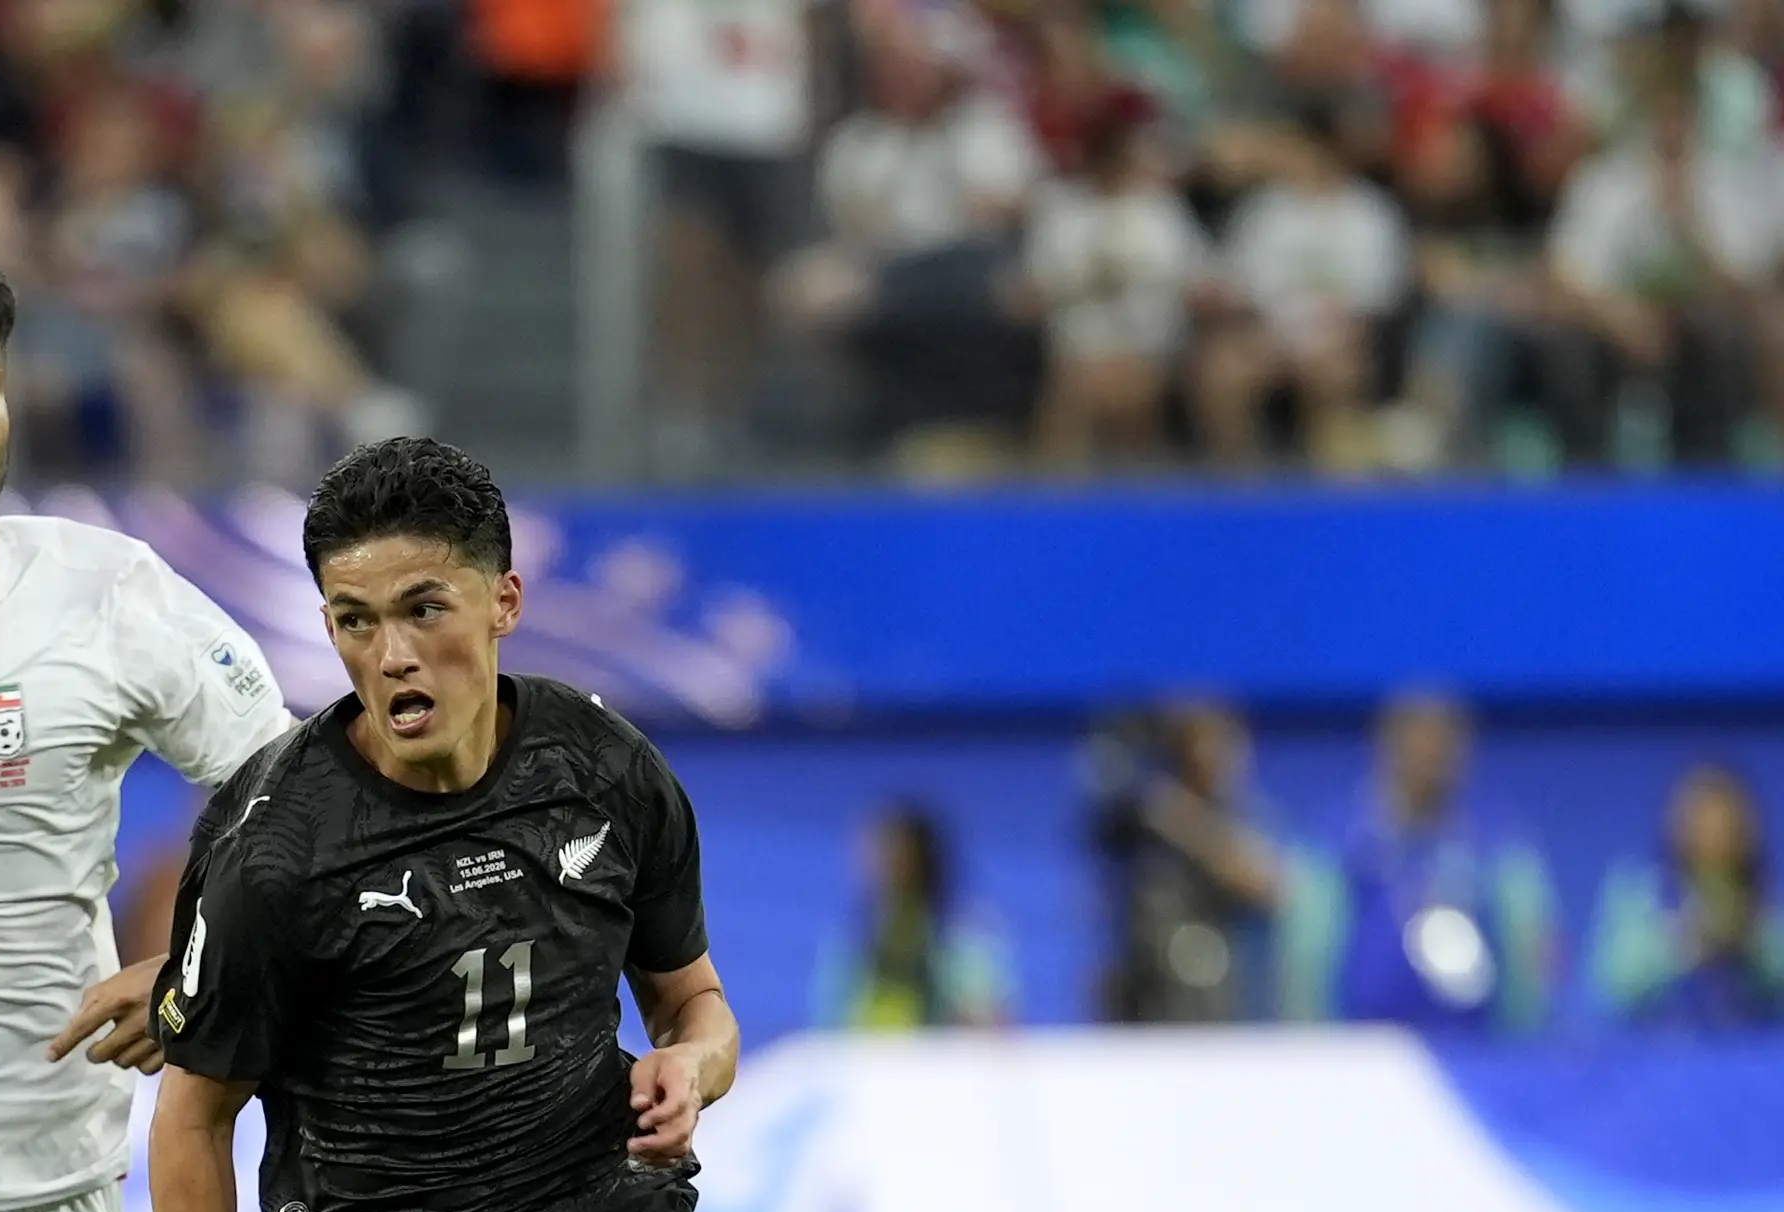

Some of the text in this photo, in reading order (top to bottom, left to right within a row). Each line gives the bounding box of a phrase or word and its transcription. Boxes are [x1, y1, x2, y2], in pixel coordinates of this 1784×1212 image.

[456, 856, 475, 868] NZL
[487, 849, 505, 860] IRN
[503, 868, 524, 880] USA
[441, 939, 536, 1071] 11
